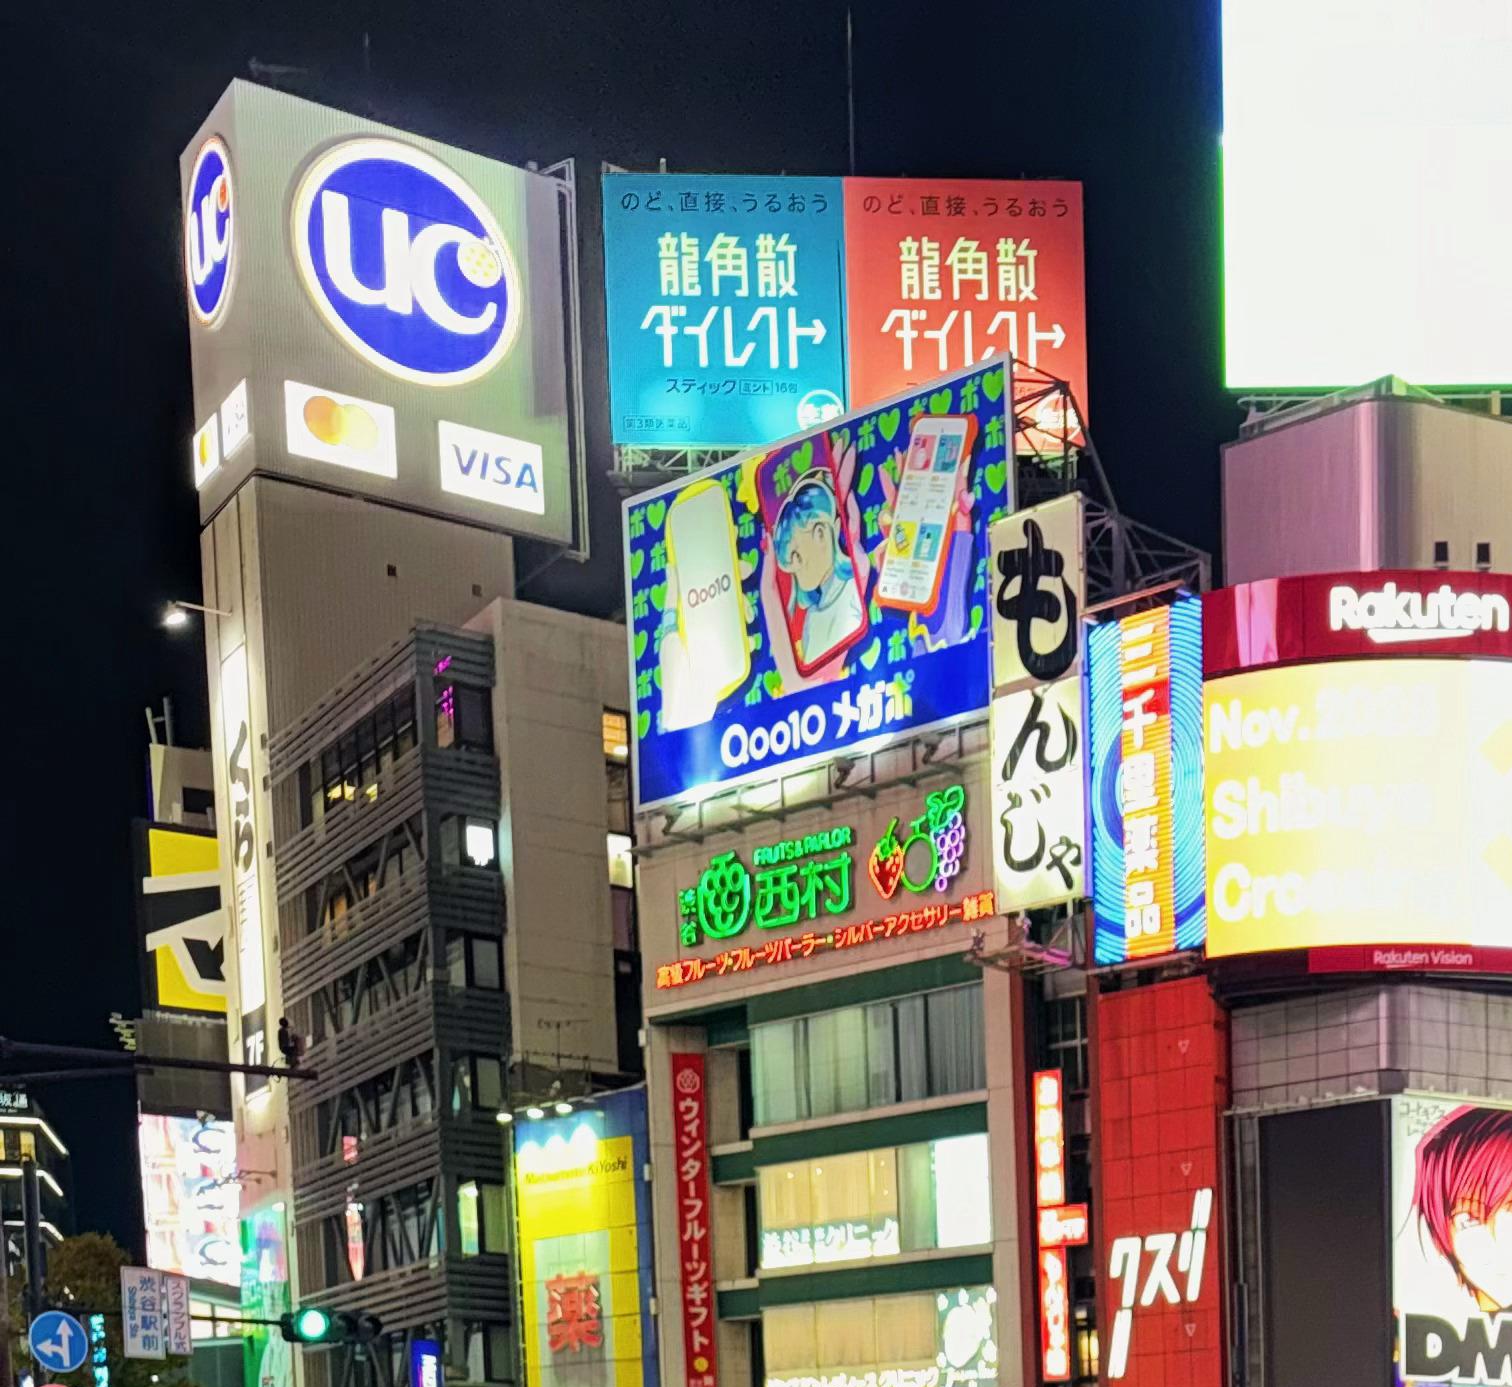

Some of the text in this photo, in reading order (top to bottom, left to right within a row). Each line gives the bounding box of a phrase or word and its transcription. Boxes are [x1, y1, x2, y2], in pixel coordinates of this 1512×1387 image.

[658, 231, 798, 298] 龍角散
[899, 236, 1039, 303] 龍角散
[640, 304, 828, 369] ダイレクト
[665, 378, 737, 396] スティック
[451, 443, 539, 494] VISA
[687, 574, 732, 609] Qoo10
[1328, 582, 1510, 632] Rakuten
[719, 705, 828, 769] Qoo10
[996, 518, 1082, 890] もんじゃ
[1208, 699, 1312, 754] Nov.
[754, 851, 852, 929] 西村
[1373, 948, 1473, 969] Rakuten Vision
[678, 1096, 710, 1353] ウィンターフルーツギフト
[140, 1275, 159, 1351] 渋谷駅前
[171, 1280, 187, 1353] スクランブル式
[544, 1271, 603, 1353] 薬
